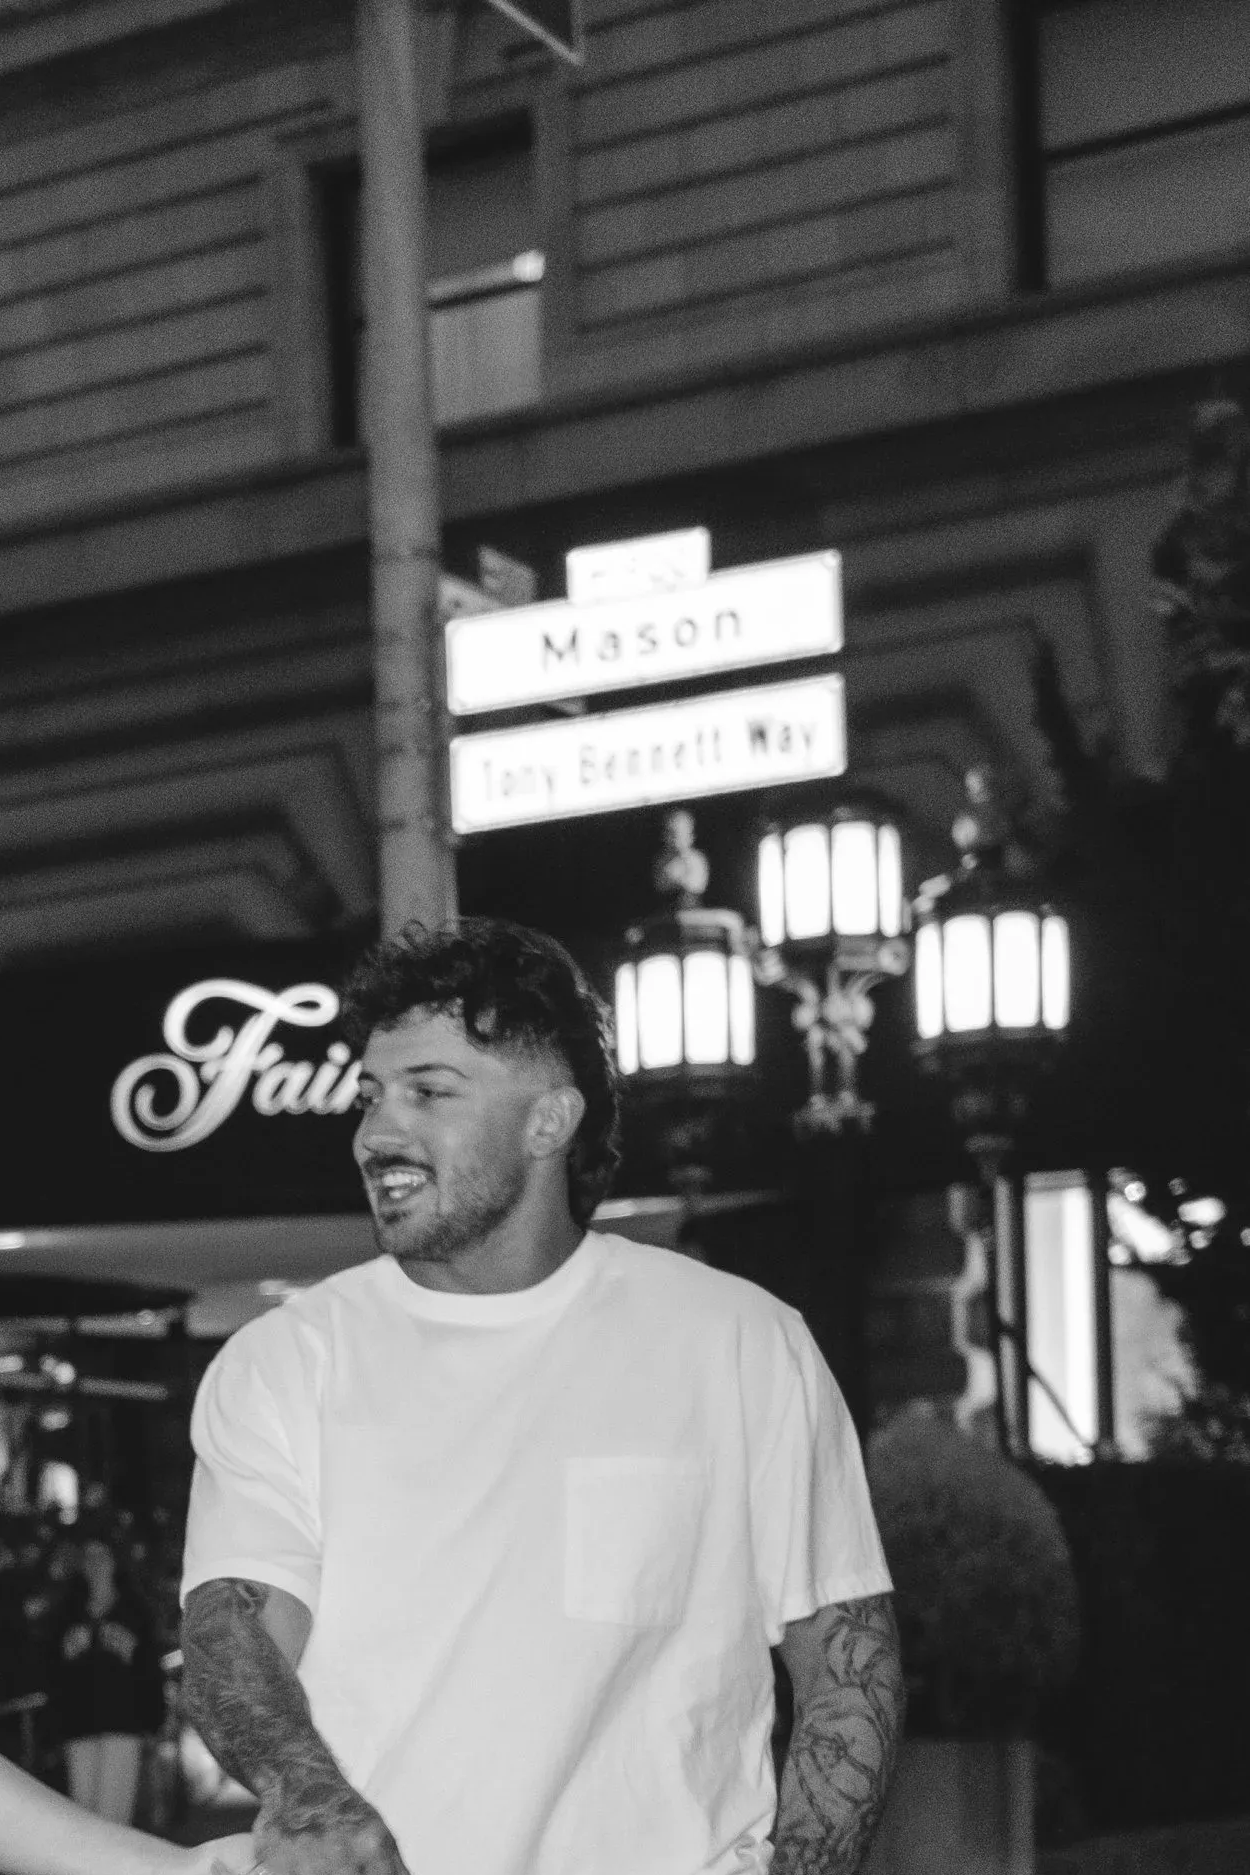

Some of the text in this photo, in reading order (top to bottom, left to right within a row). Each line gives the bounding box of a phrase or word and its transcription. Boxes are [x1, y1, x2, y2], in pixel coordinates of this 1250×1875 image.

[538, 606, 743, 673] Mason
[578, 724, 724, 787] Bennett
[745, 714, 820, 763] Way
